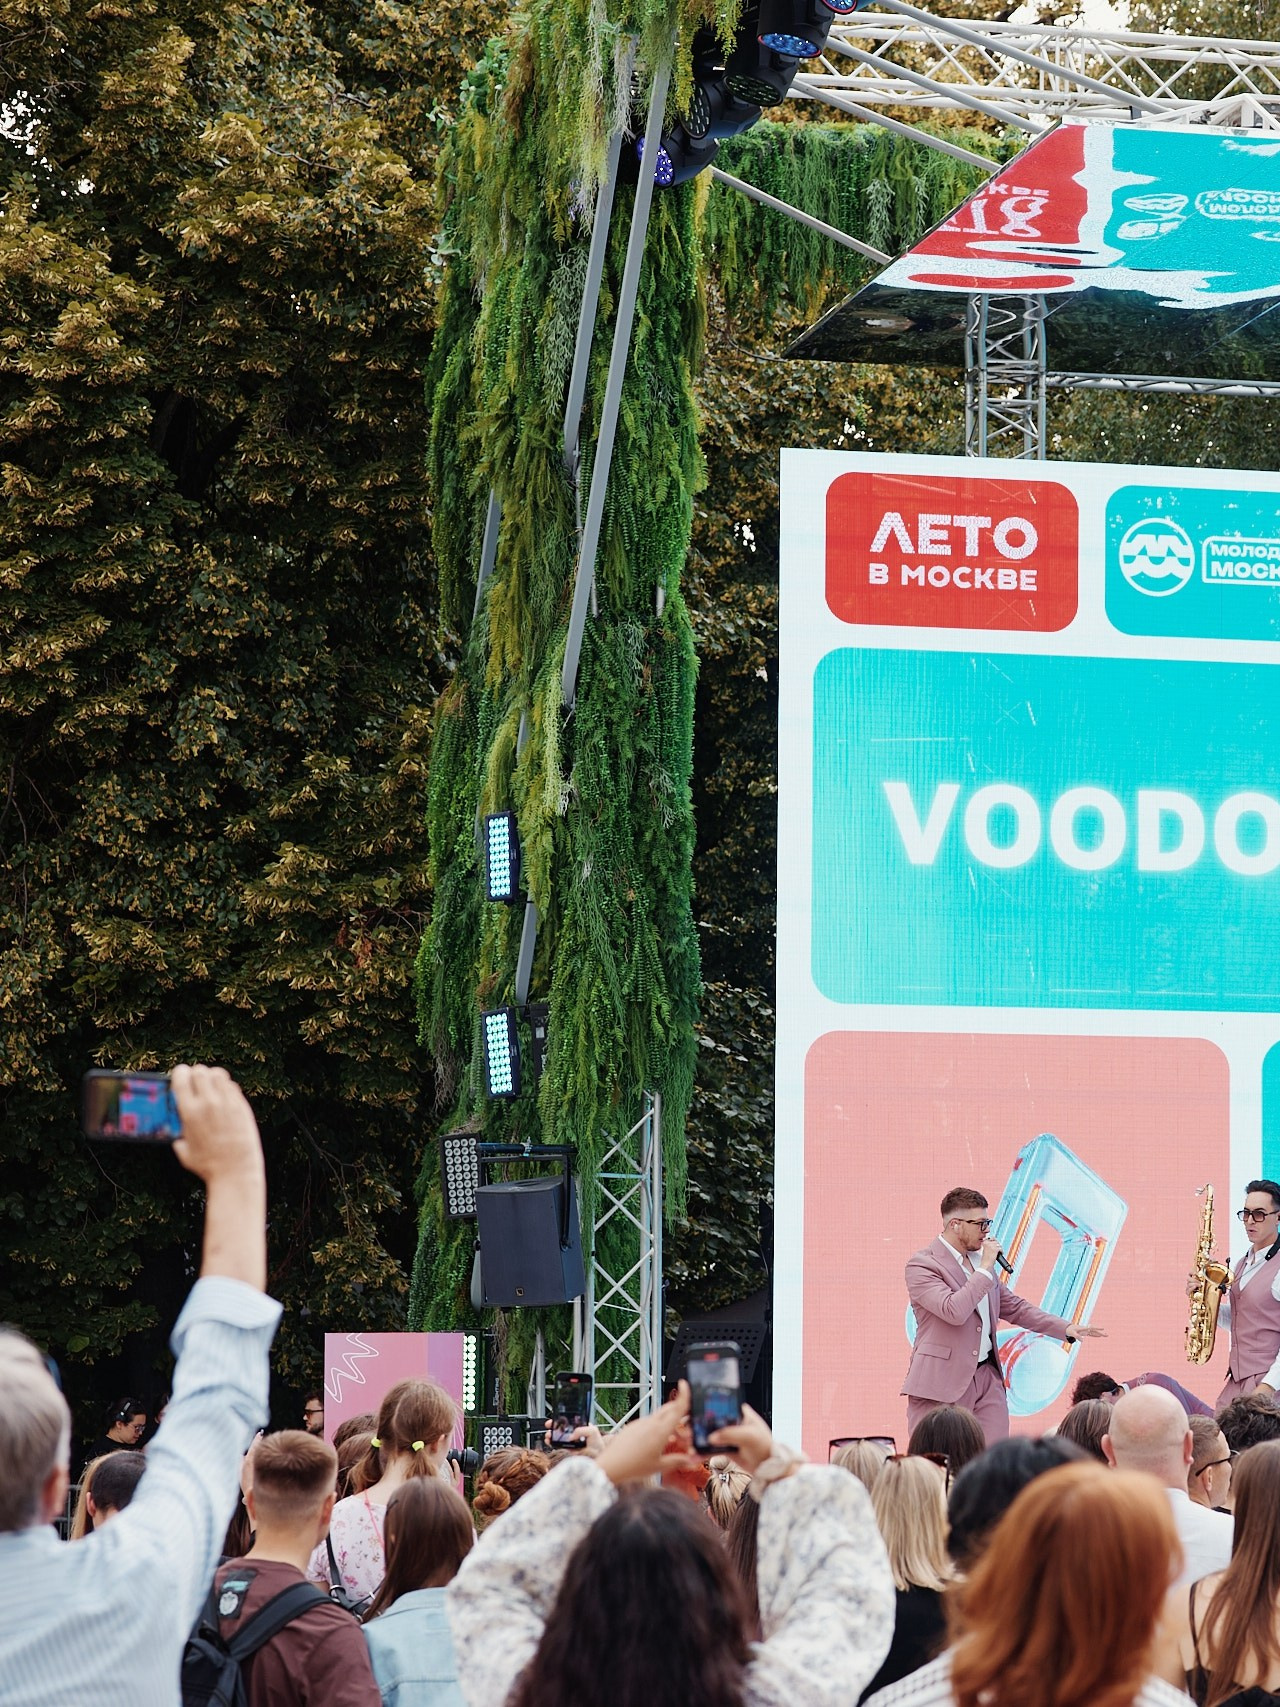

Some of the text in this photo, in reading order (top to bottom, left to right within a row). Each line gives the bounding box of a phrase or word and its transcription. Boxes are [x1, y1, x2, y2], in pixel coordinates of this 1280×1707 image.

[869, 511, 1038, 560] ЛЕТО
[868, 562, 1038, 592] В МОСКВЕ
